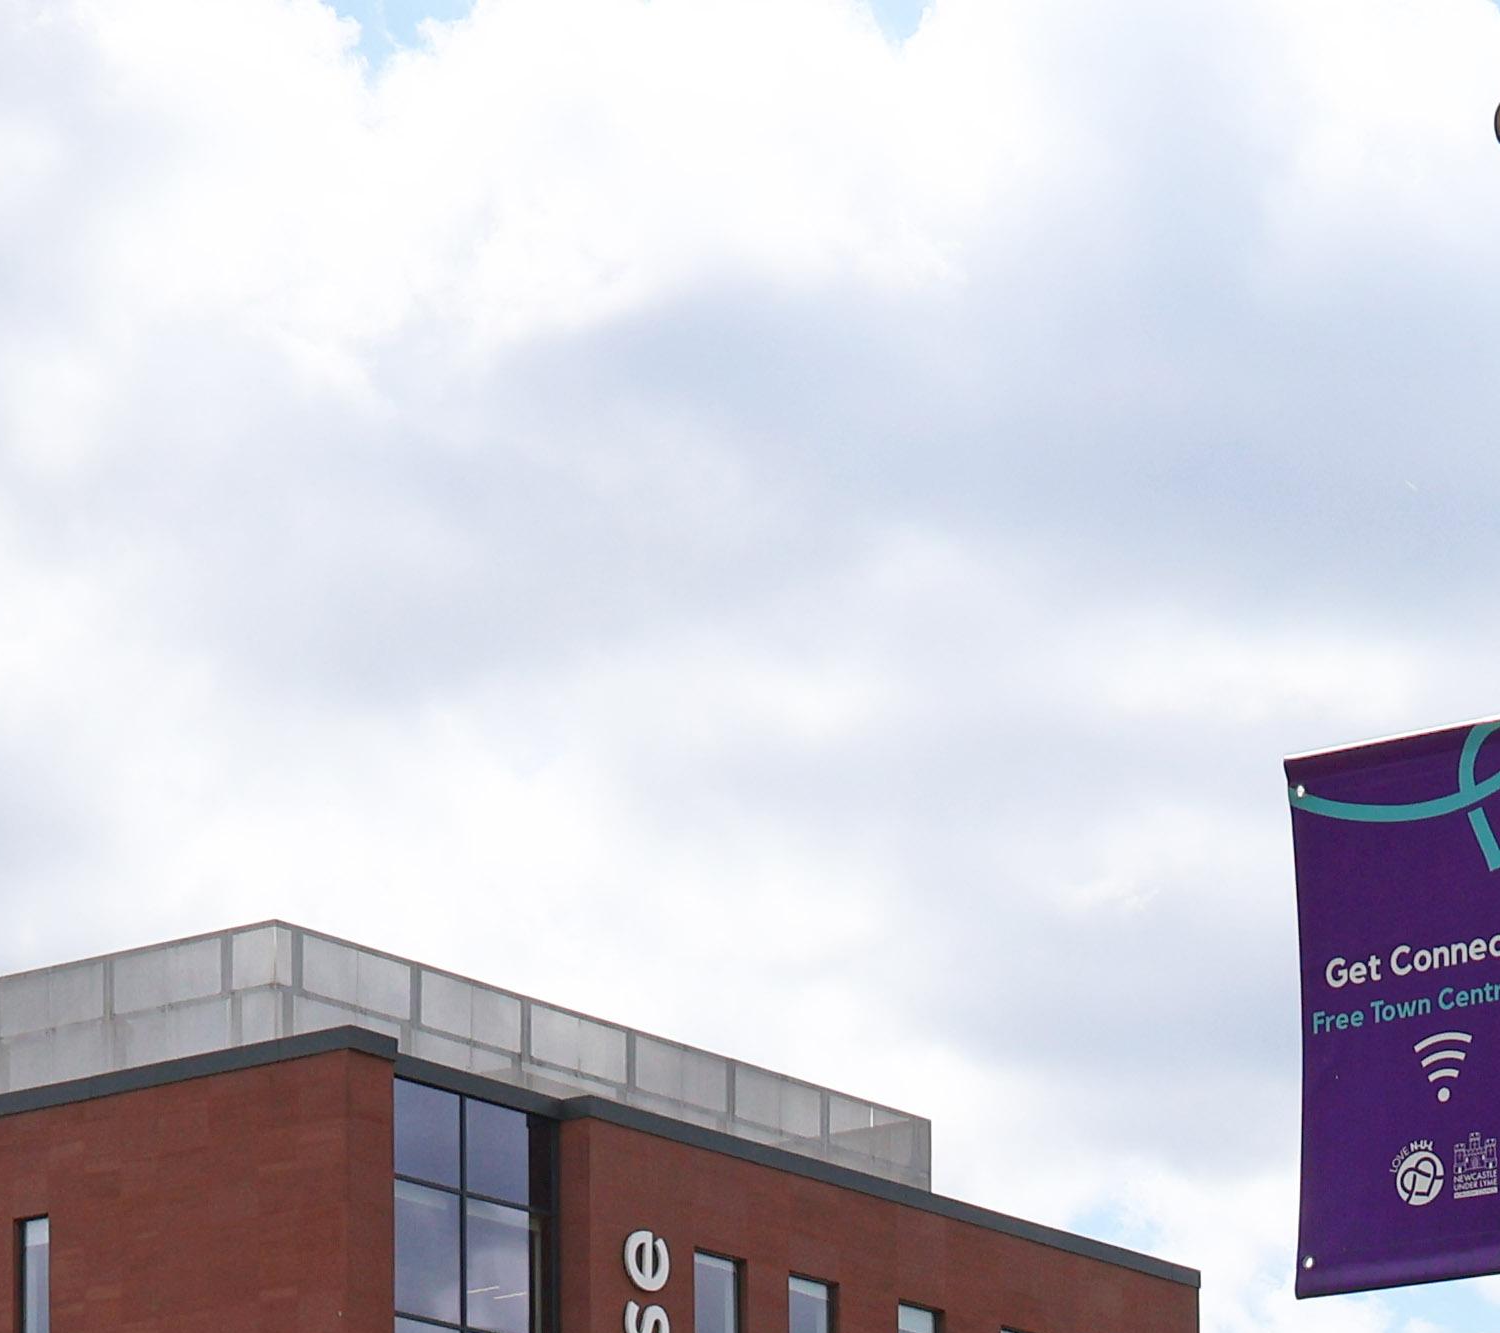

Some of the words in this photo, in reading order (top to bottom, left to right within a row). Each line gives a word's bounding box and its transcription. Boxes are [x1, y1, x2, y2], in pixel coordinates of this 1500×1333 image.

[1325, 956, 1381, 989] Get
[1311, 1010, 1364, 1035] Free
[1370, 998, 1431, 1024] Town
[1389, 1146, 1411, 1174] LOVE
[1453, 1168, 1498, 1183] NEWCASTLE
